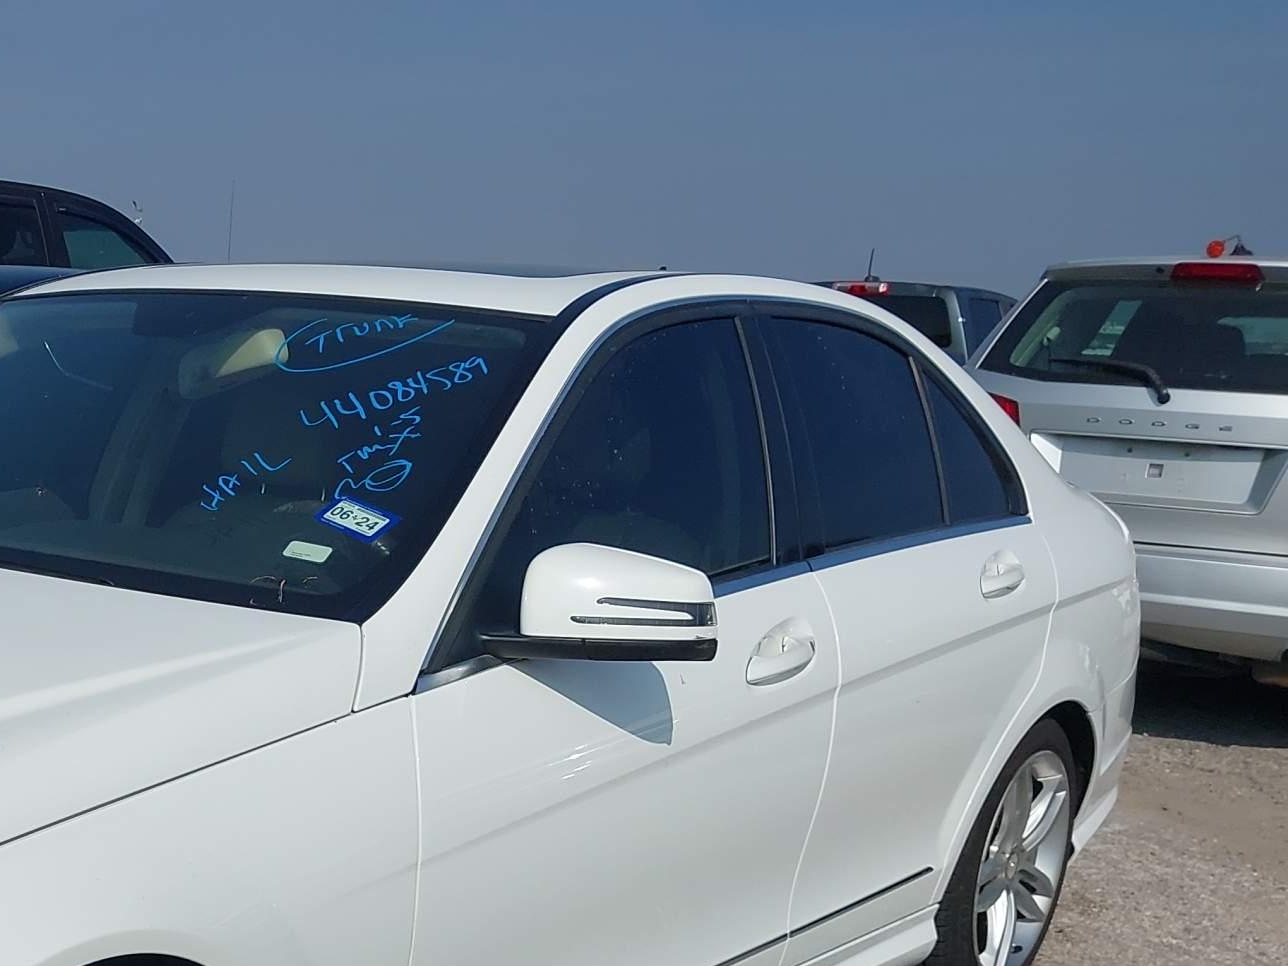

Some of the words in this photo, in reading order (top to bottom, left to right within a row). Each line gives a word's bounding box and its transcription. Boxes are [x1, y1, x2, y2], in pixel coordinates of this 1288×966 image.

[299, 355, 489, 429] 44084589
[1086, 416, 1233, 432] DODGE
[200, 452, 293, 511] HAIL
